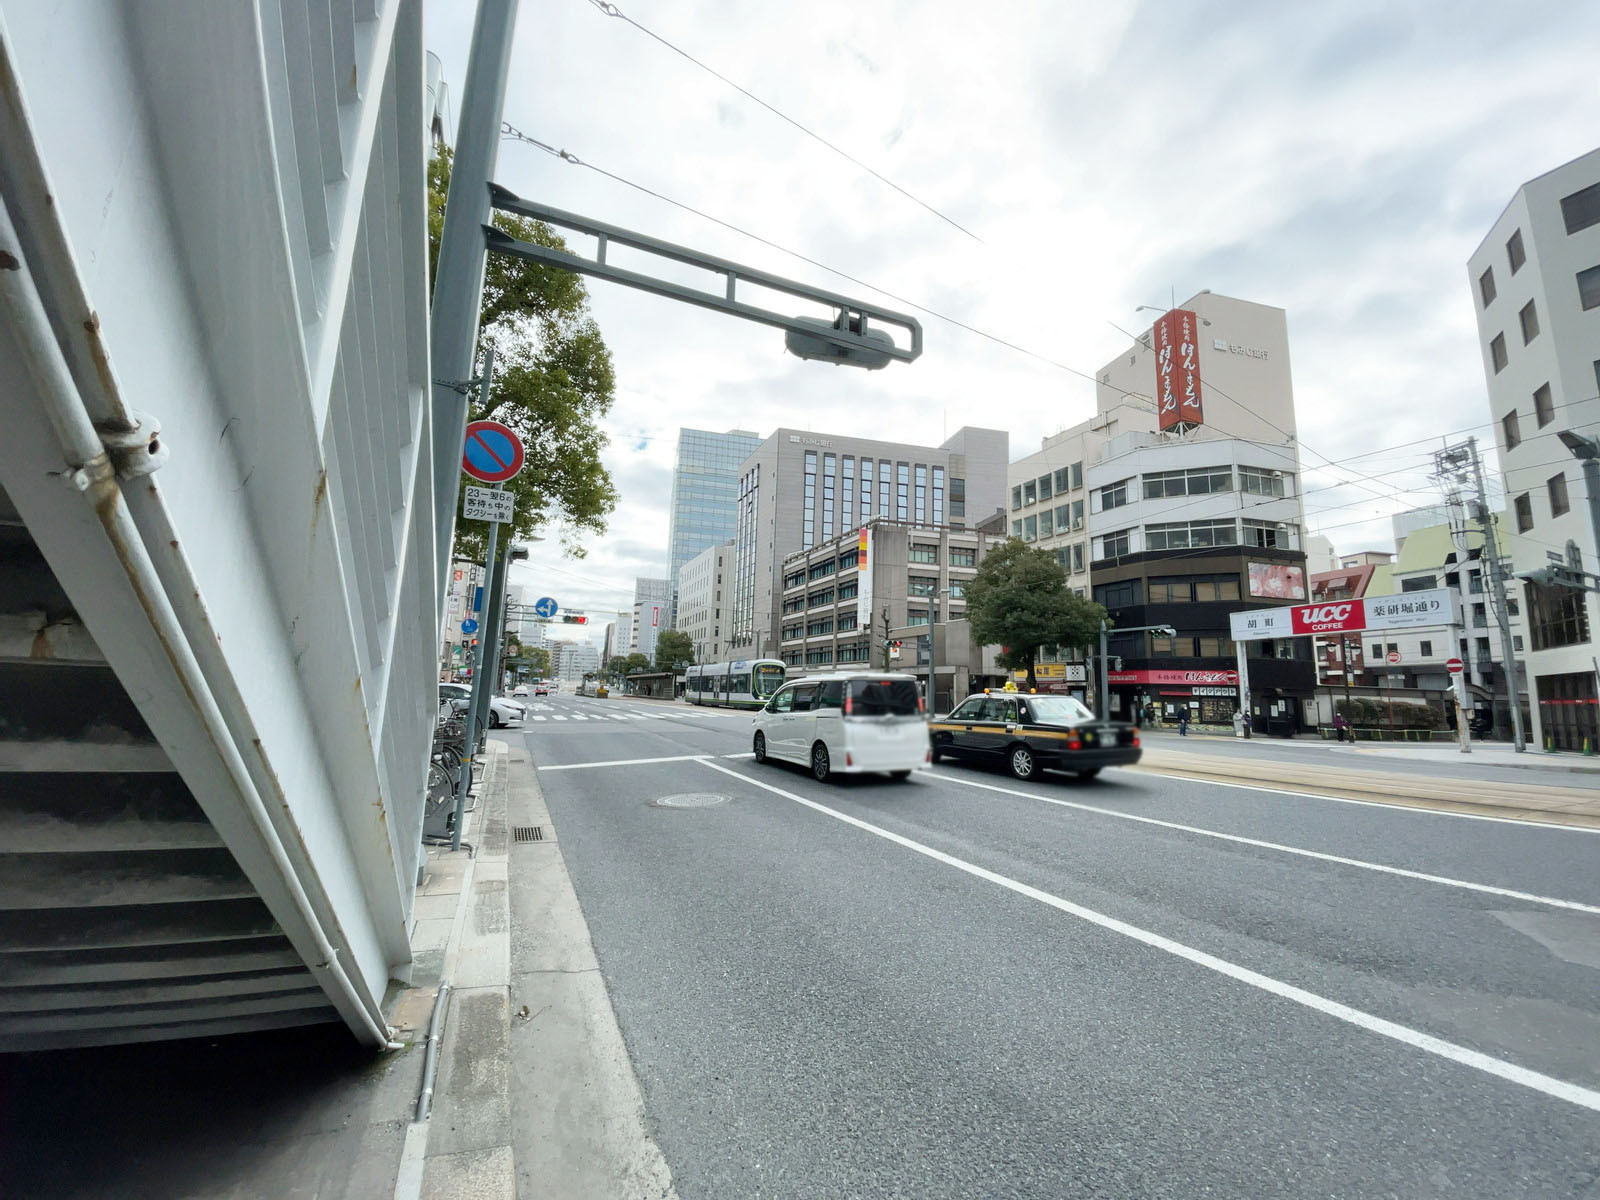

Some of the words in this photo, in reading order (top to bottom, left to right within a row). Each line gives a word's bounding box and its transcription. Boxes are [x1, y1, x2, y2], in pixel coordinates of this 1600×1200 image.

[467, 498, 511, 511] 客待ち中の
[466, 507, 510, 521] タクシーを除く
[1301, 604, 1352, 624] UCC
[1373, 600, 1440, 617] 薬研堀通り
[1312, 622, 1344, 631] COFFEE
[1193, 688, 1236, 696] テイクアウト
